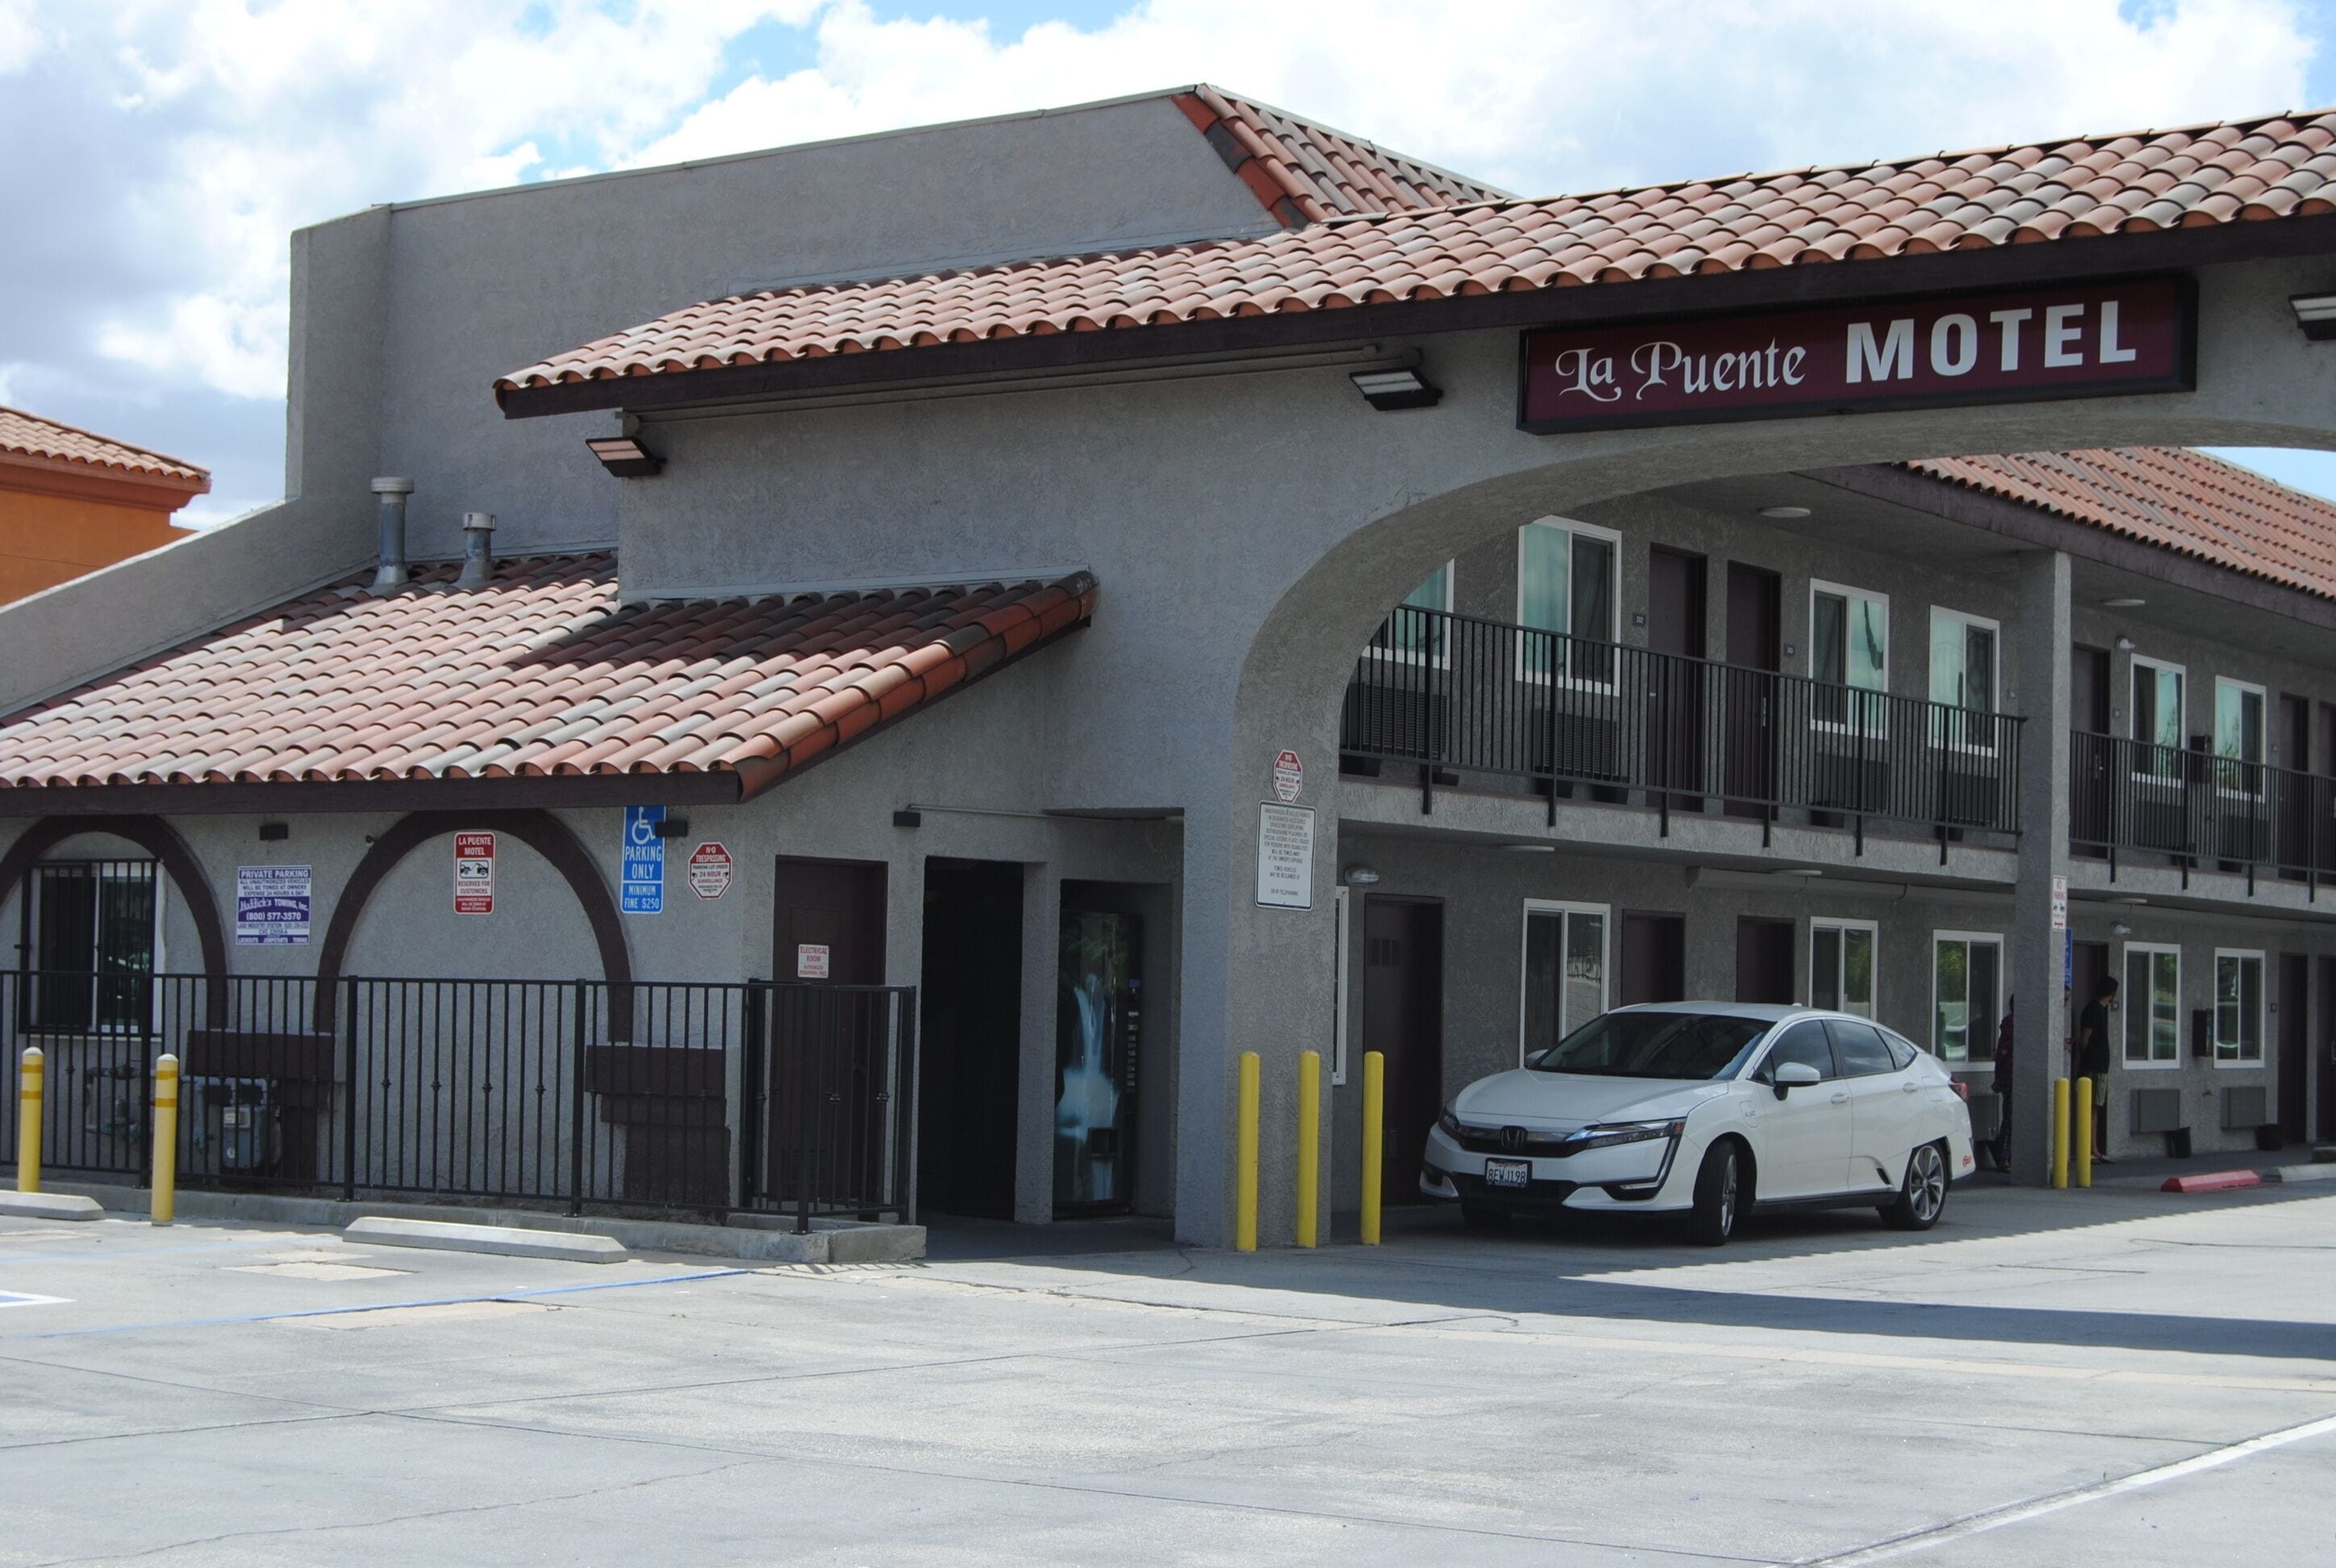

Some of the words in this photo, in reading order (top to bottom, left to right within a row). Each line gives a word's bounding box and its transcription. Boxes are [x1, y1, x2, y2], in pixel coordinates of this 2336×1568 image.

[1555, 348, 1622, 402] La
[1631, 337, 1807, 400] Puente
[1846, 301, 2136, 384] MOTEL
[458, 837, 466, 845] LA
[467, 837, 491, 845] PUENTE
[465, 847, 486, 855] MOTEL
[625, 846, 661, 861] PARKING
[696, 854, 726, 862] TRESPASSING
[240, 870, 273, 878] PRIVATE
[275, 870, 309, 878] PARKING
[632, 863, 654, 879] ONLY
[628, 885, 656, 895] MINIMUM
[624, 898, 638, 908] FINE
[641, 898, 659, 909] $250
[246, 912, 265, 920] (800)
[267, 912, 302, 920] 577-3570
[800, 946, 827, 954] ELECTRICAL
[1488, 1168, 1526, 1185] 8EWJ198
